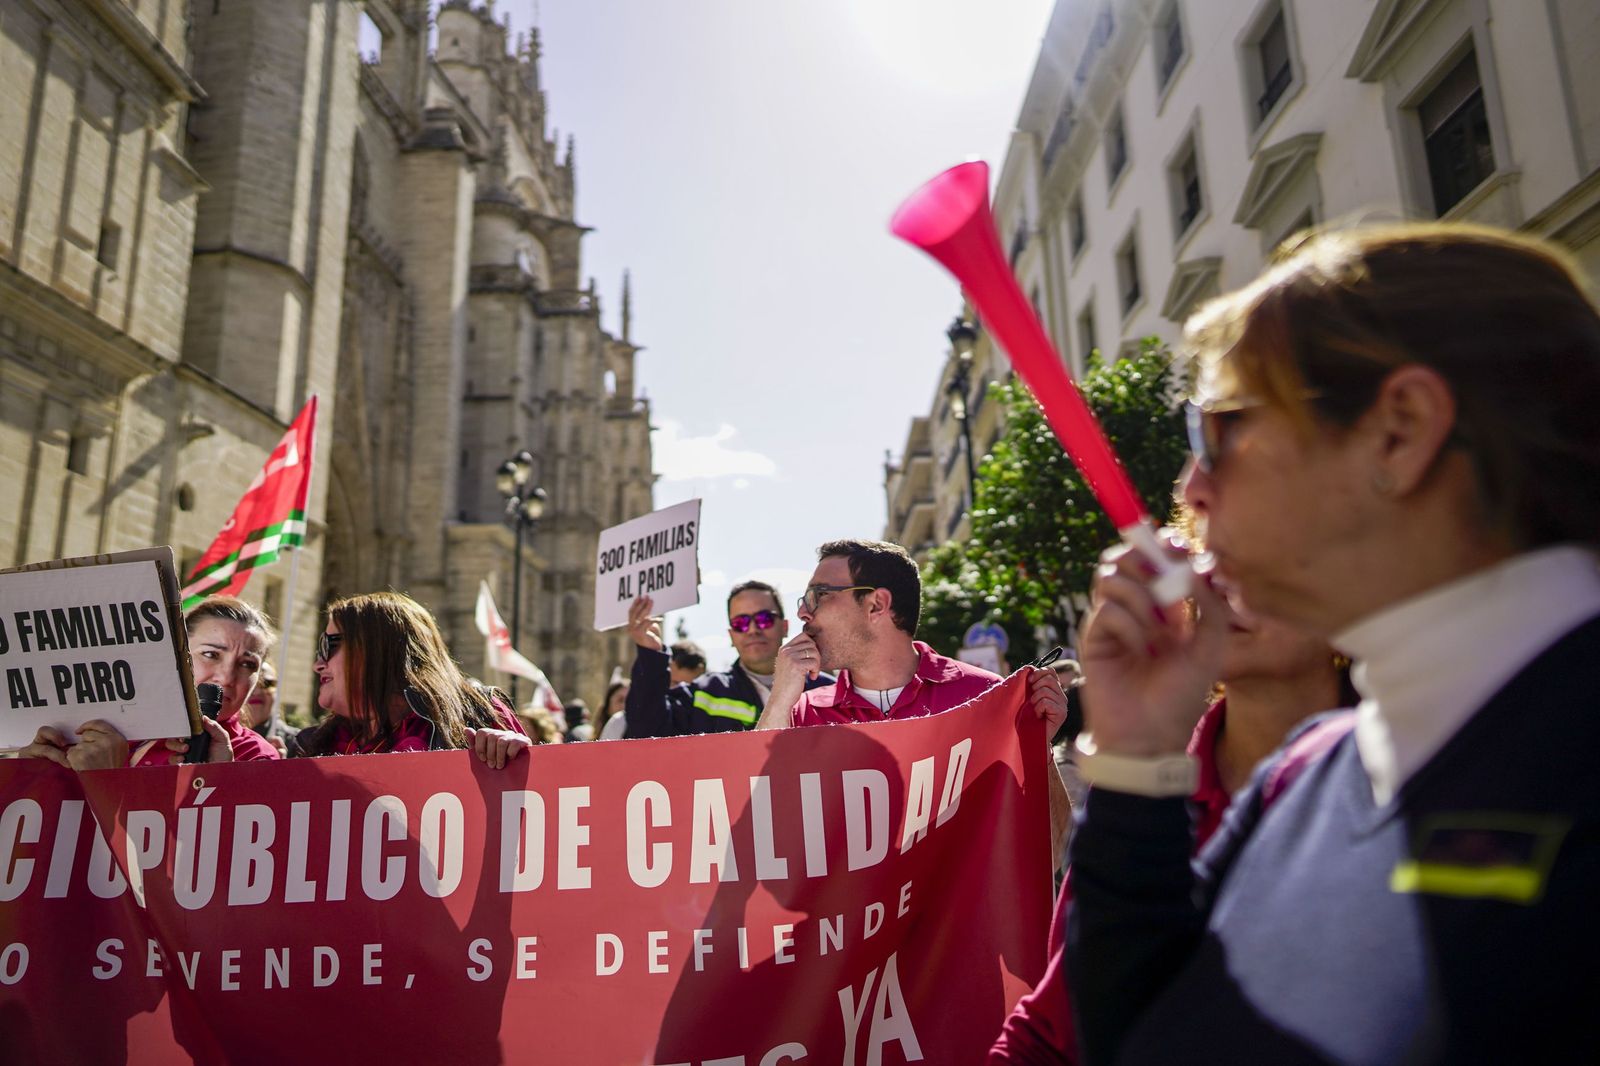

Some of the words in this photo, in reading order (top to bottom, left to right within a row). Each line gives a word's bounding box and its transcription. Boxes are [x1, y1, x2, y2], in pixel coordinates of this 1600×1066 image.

[600, 546, 625, 574] 300
[629, 521, 694, 564] FAMILIAS
[618, 575, 633, 601] AL
[638, 562, 673, 596] PARO
[14, 600, 165, 653] FAMILIAS
[6, 667, 48, 709] AL
[51, 659, 136, 705] PARO
[126, 786, 465, 910] PÚBLICO
[499, 786, 592, 893] DE
[626, 737, 972, 889] CALIDAD
[92, 938, 164, 980] SE
[177, 943, 416, 991] VENDE,
[467, 937, 537, 982] SE
[595, 880, 913, 976] DEFIENDE
[837, 951, 924, 1066] YA
